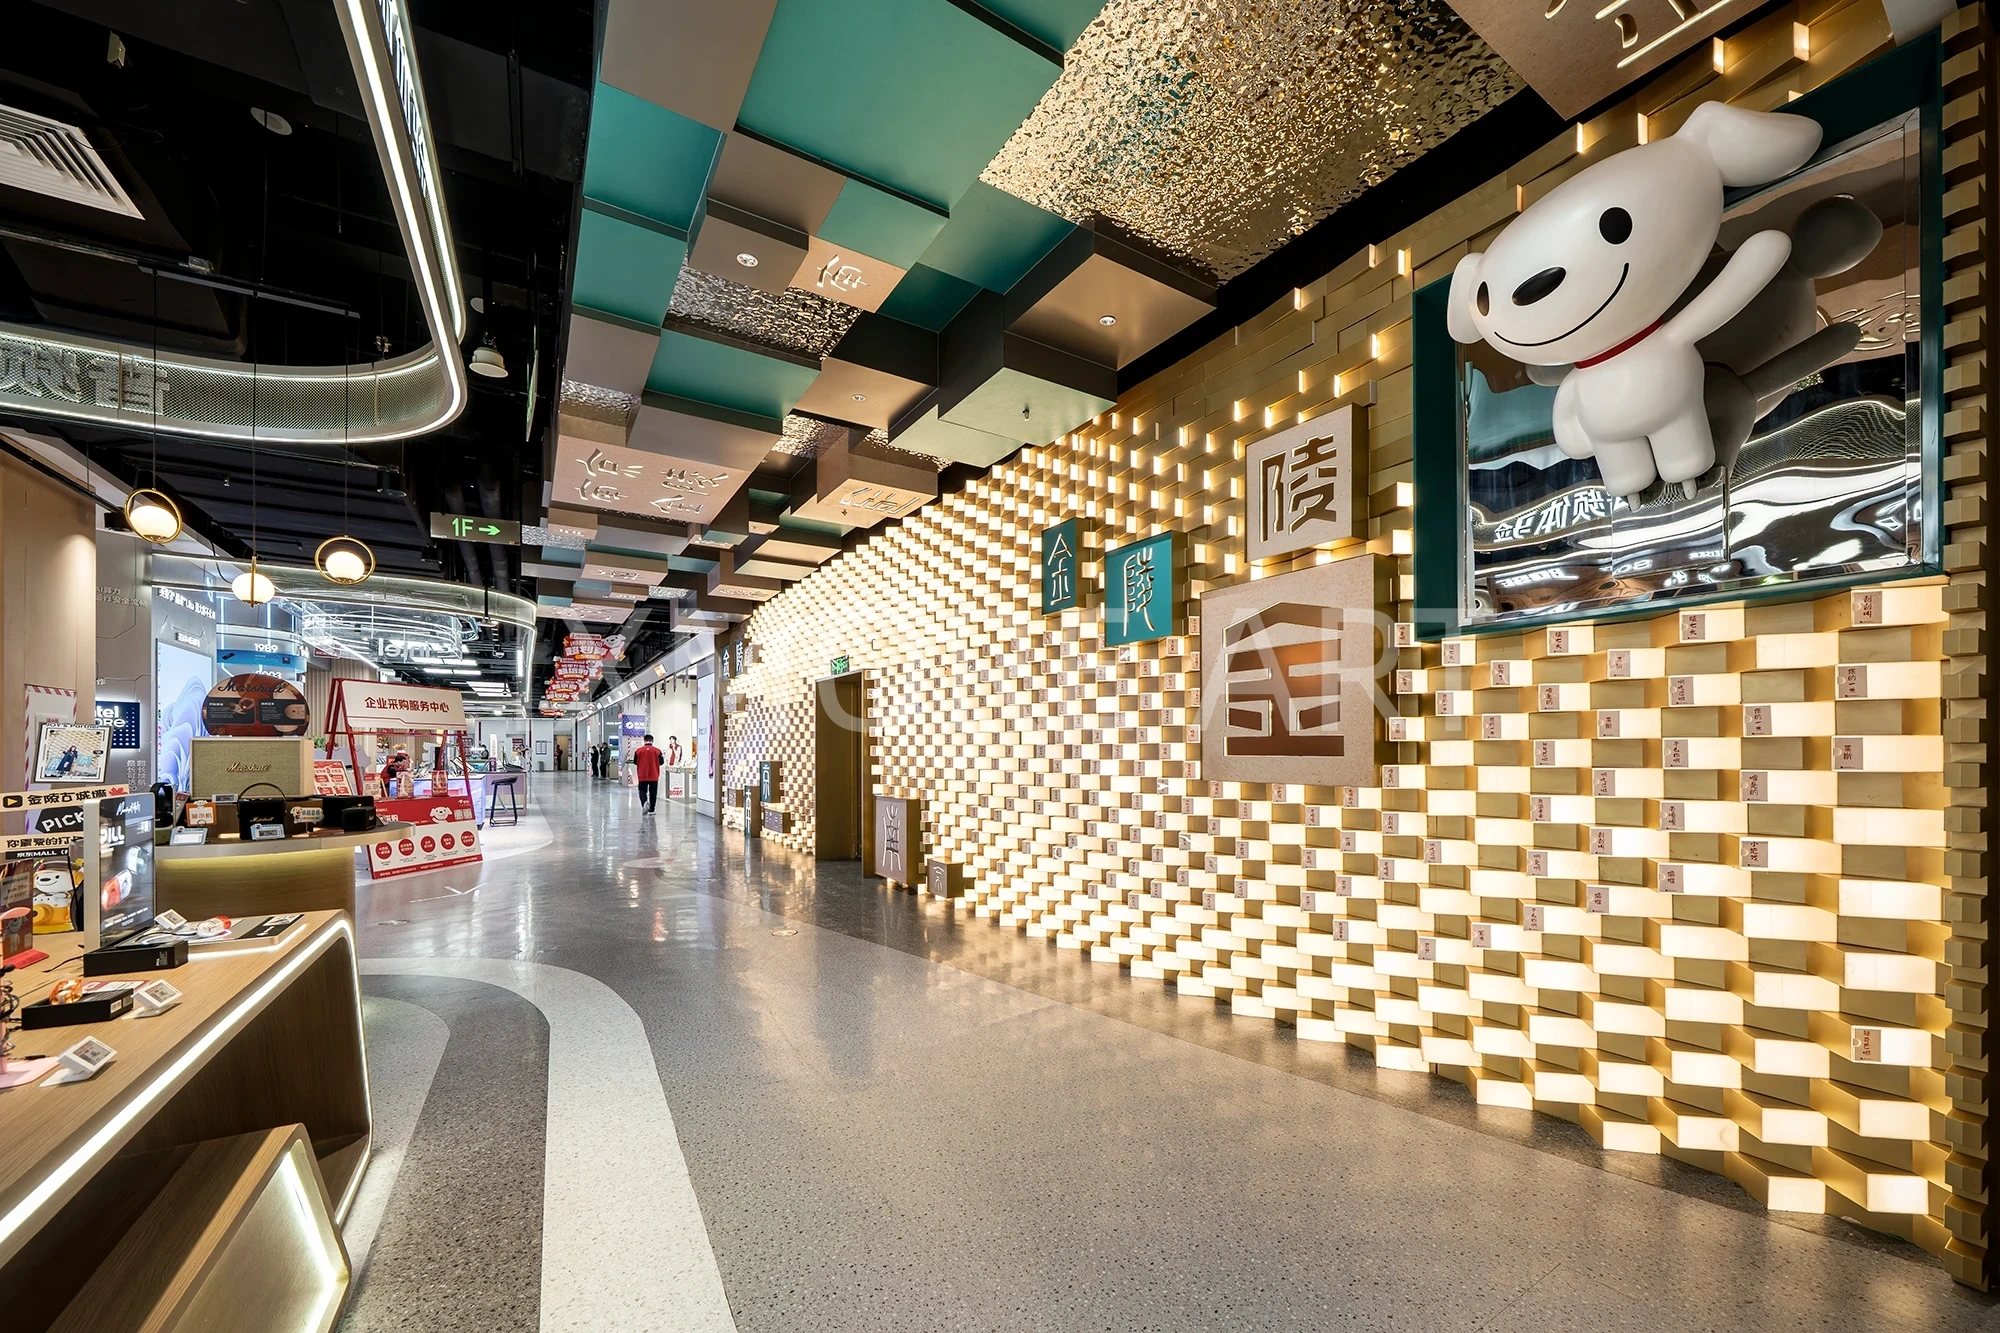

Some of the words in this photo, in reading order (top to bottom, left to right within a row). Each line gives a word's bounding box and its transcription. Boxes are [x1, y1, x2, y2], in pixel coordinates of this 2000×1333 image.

[1259, 433, 1339, 543] 陵
[452, 518, 474, 537] 1F
[253, 643, 279, 653] 1989
[218, 681, 289, 695] Marshall
[1223, 601, 1346, 758] 金
[364, 696, 450, 713] 企业采购服务中心
[225, 762, 271, 774] Marshall
[41, 811, 85, 833] PICK
